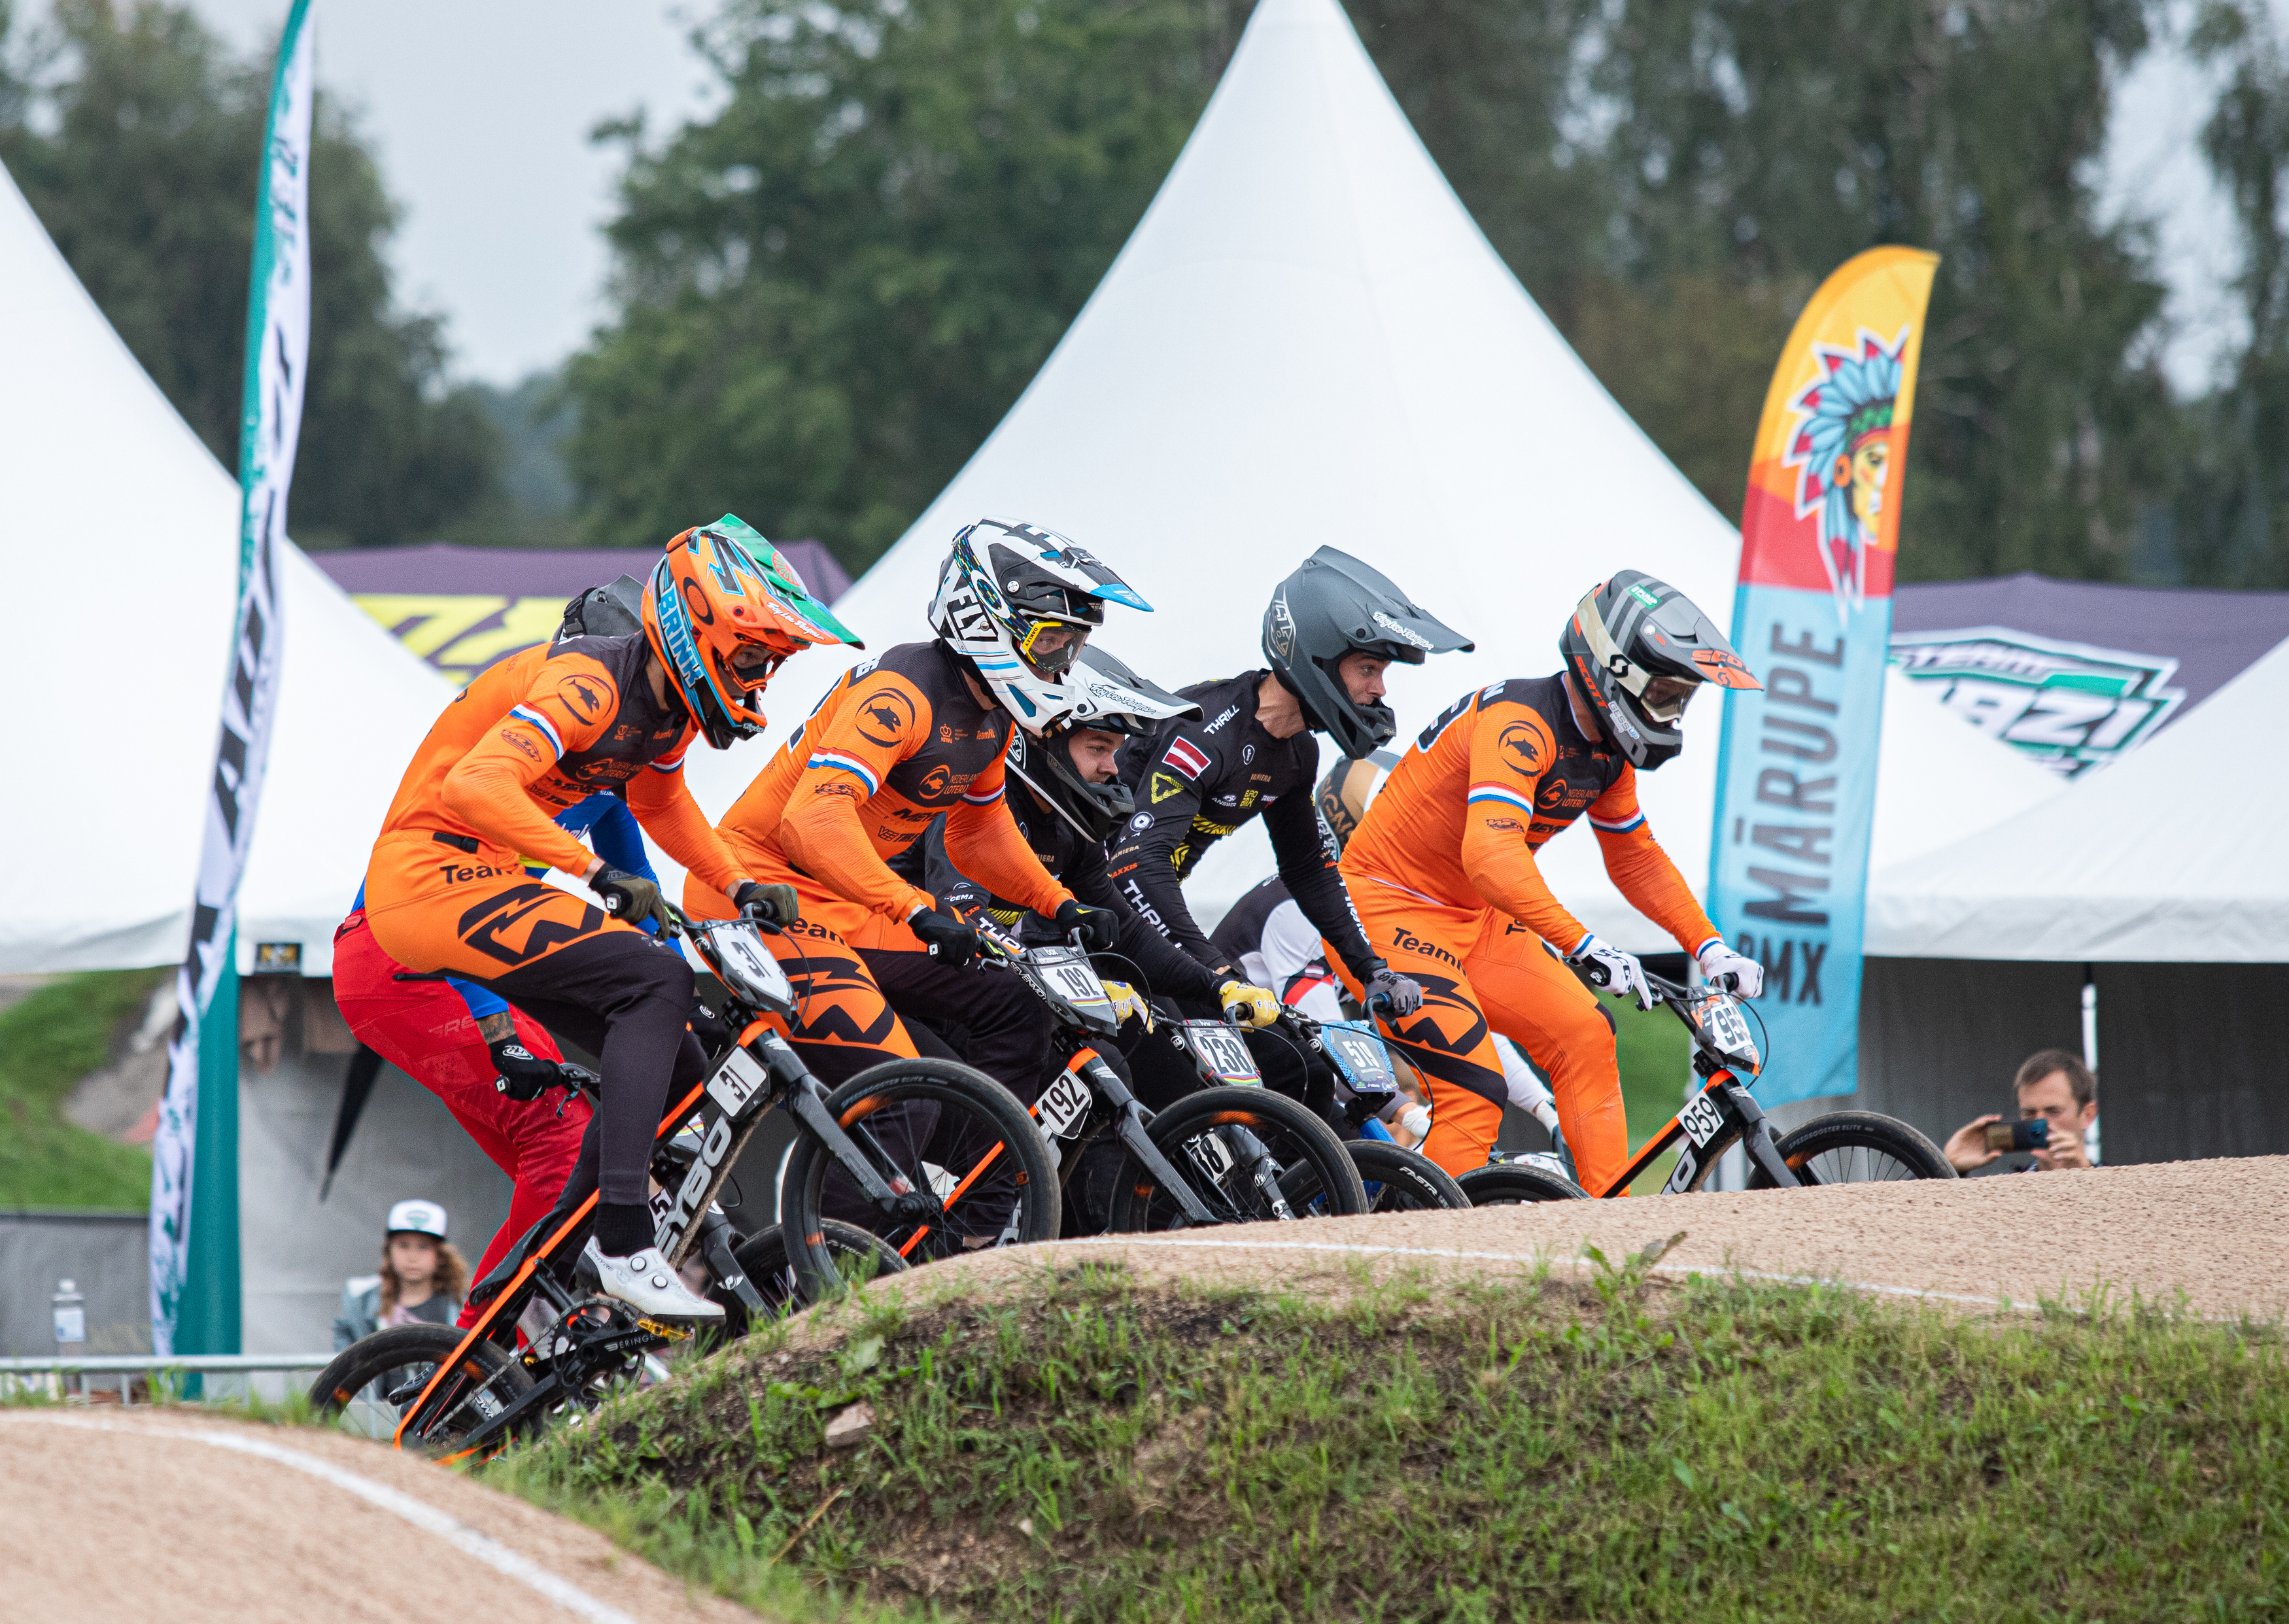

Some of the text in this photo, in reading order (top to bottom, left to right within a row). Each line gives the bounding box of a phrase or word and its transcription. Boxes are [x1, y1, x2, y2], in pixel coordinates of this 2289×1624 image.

[948, 585, 998, 640] FLY
[1373, 612, 1391, 628] Troy
[659, 581, 704, 688] BRINK
[1025, 627, 1039, 647] OAKLEY
[1090, 683, 1156, 712] Troy Lee Designs
[1575, 655, 1608, 708] SCOTT
[1203, 704, 1239, 735] THRILL
[1734, 621, 1845, 925] MĀRUPE
[1211, 797, 1237, 807] ANSWER
[731, 941, 773, 979] 31
[1056, 967, 1100, 997] 192
[1199, 1036, 1252, 1074] 238
[1342, 1041, 1381, 1068] 519
[719, 1064, 754, 1103] 31
[1042, 1075, 1086, 1127] 192
[1683, 1096, 1722, 1143] 959
